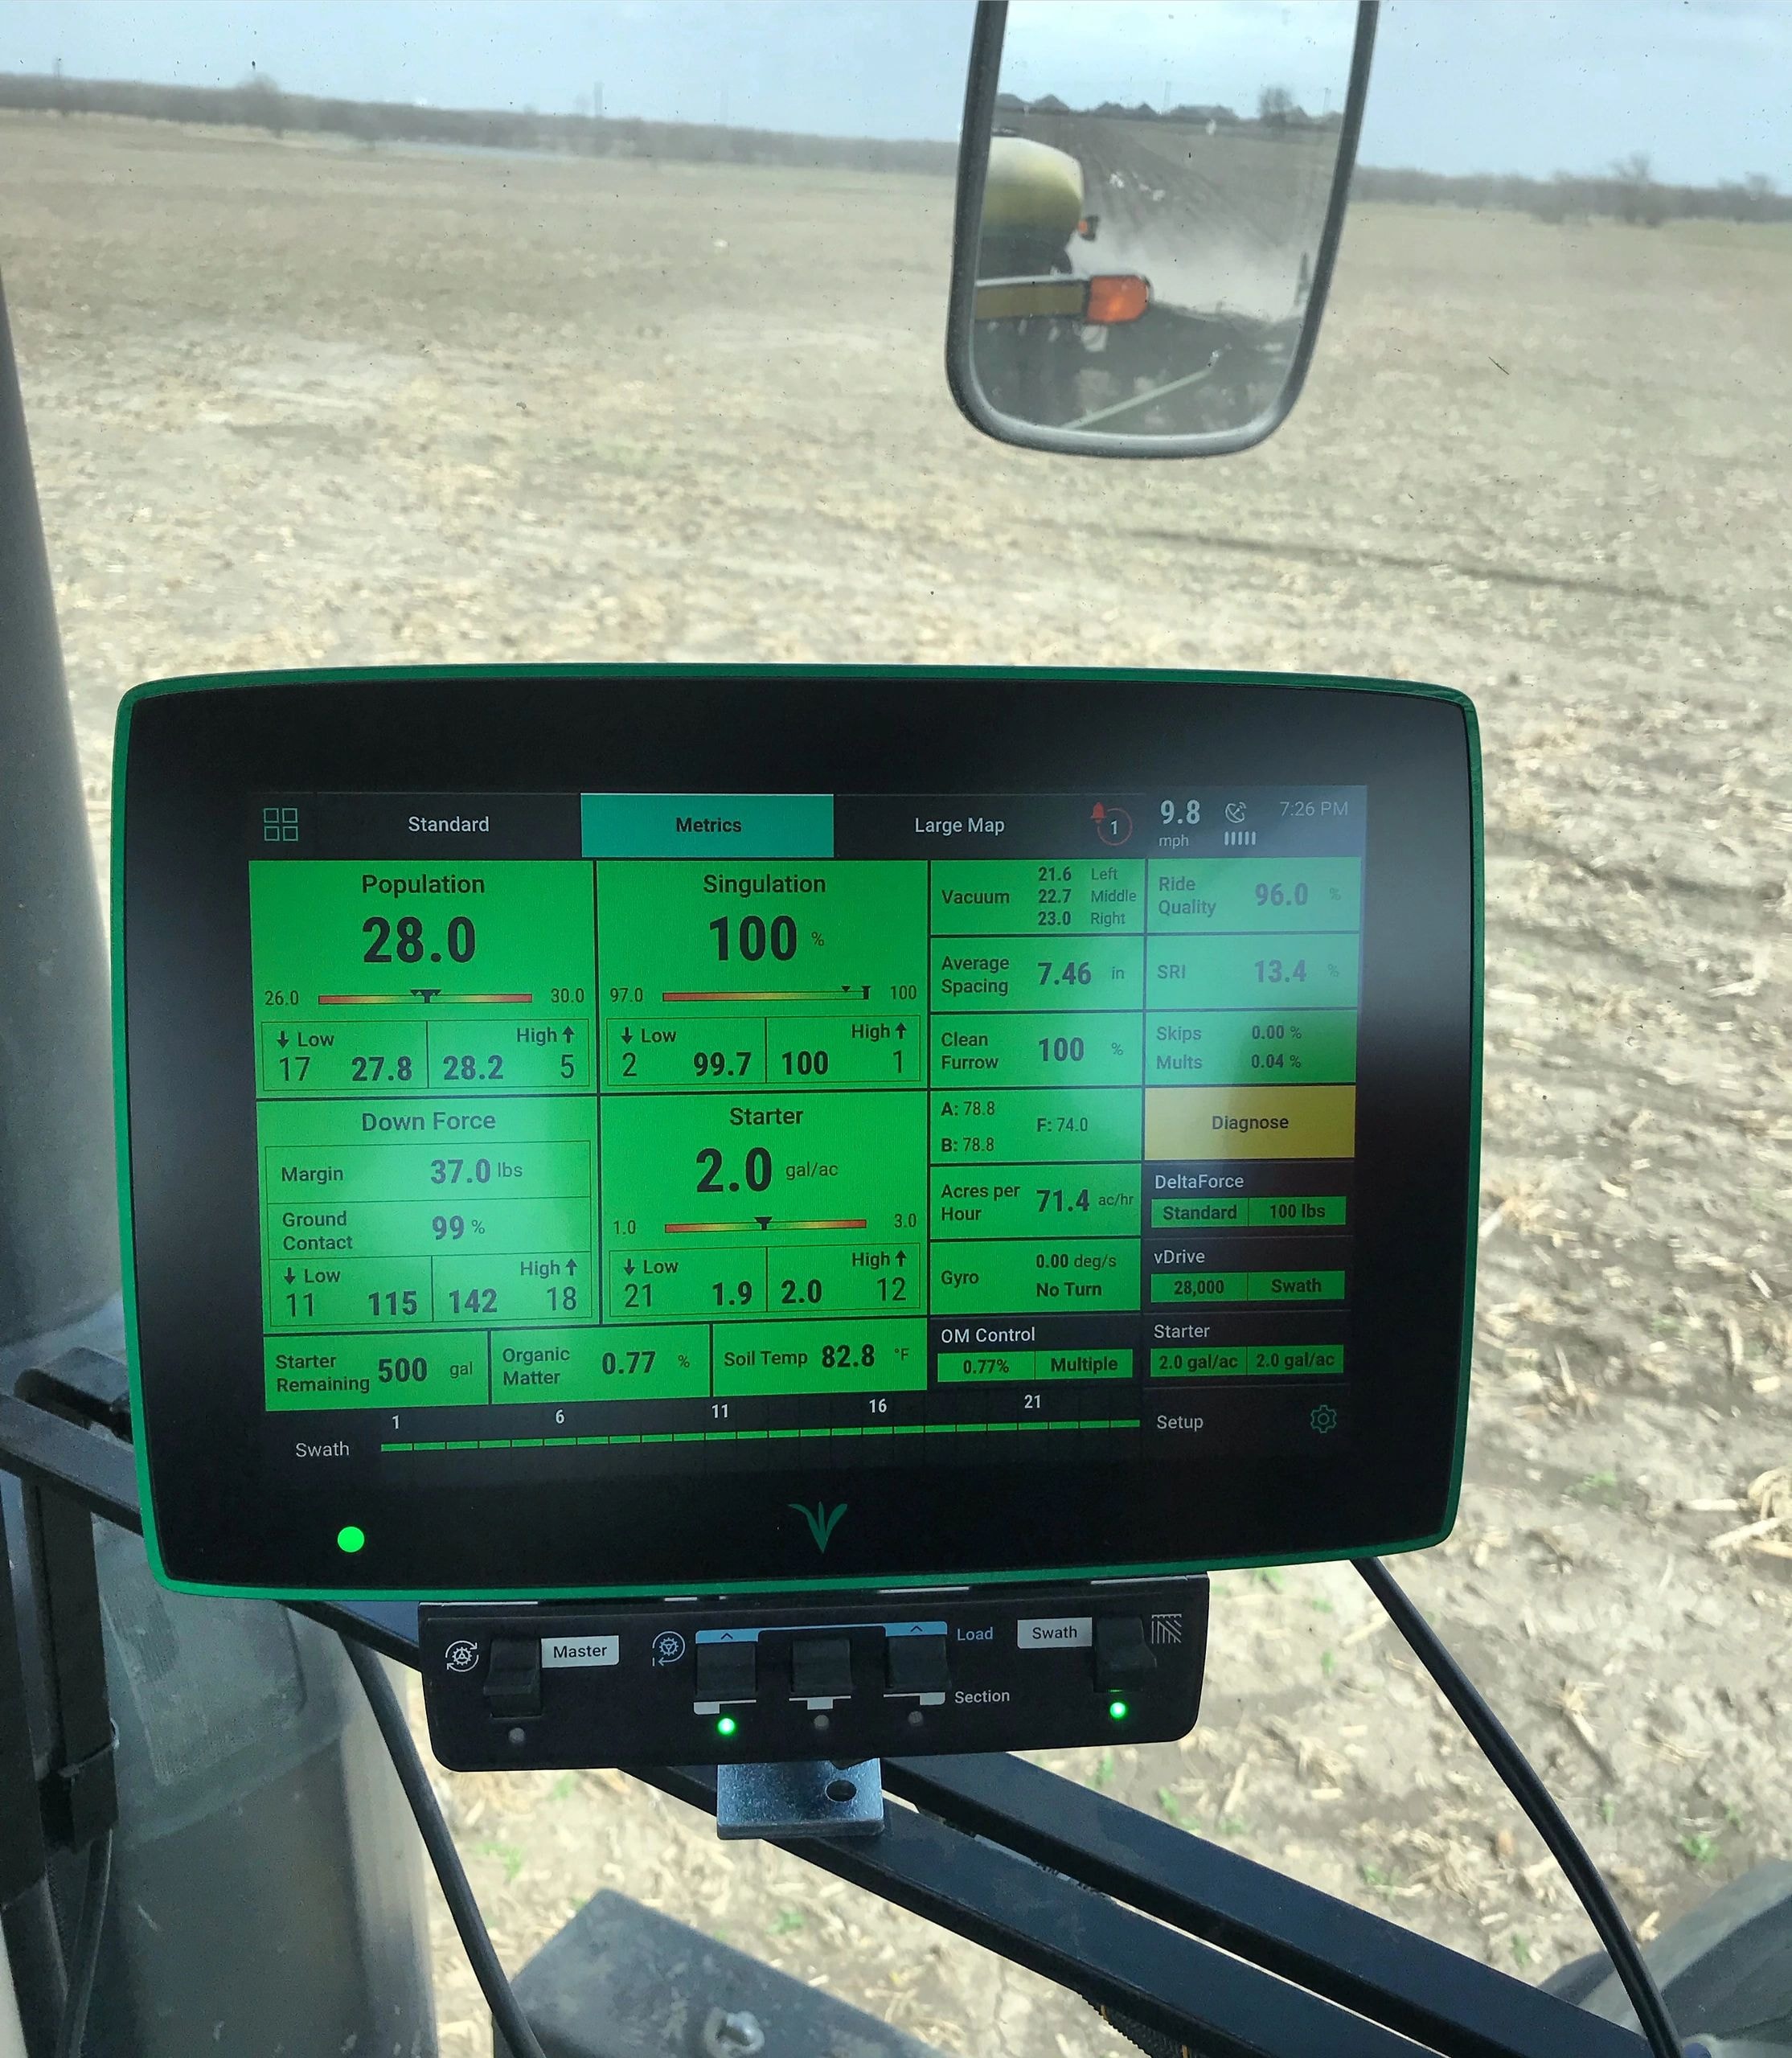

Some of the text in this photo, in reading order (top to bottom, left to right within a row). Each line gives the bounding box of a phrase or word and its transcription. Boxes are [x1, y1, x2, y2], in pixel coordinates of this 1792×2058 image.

[1161, 800, 1199, 824] 9.8
[1280, 801, 1347, 816] 7:26 PM
[409, 816, 489, 831] Standard
[677, 817, 743, 833] Metrics
[916, 818, 1004, 835] Large Map
[1111, 820, 1117, 834] 1
[1159, 834, 1188, 849] mph
[1039, 866, 1117, 882] 21.6 Left
[362, 874, 485, 898] Population
[703, 874, 825, 899] Singulation
[1159, 876, 1195, 891] Ride
[941, 890, 1011, 905] Vacuum
[1039, 888, 1137, 903] 22.7 Middle
[1256, 883, 1308, 906] 96.0
[1158, 899, 1216, 917] Quality
[1038, 910, 1126, 927] 23.0 Right
[363, 915, 476, 964] 28.0
[709, 914, 798, 961] 100
[941, 956, 1010, 974] Average
[1038, 961, 1124, 985] 7.46 in
[1158, 965, 1185, 978] SRI
[1255, 960, 1306, 982] 13.4
[552, 987, 585, 1003] 30.0
[609, 986, 643, 1003] 97.0
[891, 985, 917, 1000] 100
[941, 978, 1010, 997] Spacing
[265, 990, 299, 1006] 26.0
[298, 1032, 334, 1047] Low
[517, 1027, 557, 1046] High
[641, 1029, 677, 1043] Low
[851, 1023, 891, 1042] High
[941, 1031, 989, 1047] Clean
[1157, 1026, 1201, 1043] Skips
[1252, 1025, 1285, 1040] 0.00
[1039, 1036, 1085, 1061] 100
[280, 1057, 310, 1081] 17
[352, 1056, 412, 1081] 27.8
[444, 1055, 503, 1080] 28.2
[561, 1053, 575, 1079] 5
[622, 1052, 637, 1077] 2
[693, 1051, 751, 1076] 99.7
[782, 1050, 829, 1076] 100
[893, 1050, 902, 1073] 1
[941, 1054, 999, 1070] Furrow
[1157, 1055, 1202, 1069] Mults
[1249, 1053, 1283, 1068] 0.04
[730, 1106, 803, 1125] Starter
[941, 1100, 995, 1117] A: 78.8
[363, 1111, 495, 1131] Down Force
[1037, 1117, 1089, 1132] F: 74.0
[1212, 1114, 1289, 1133] Diagnose
[941, 1136, 995, 1152] B: 78.8
[282, 1166, 343, 1184] Margin
[431, 1158, 522, 1184] 37.0 lbs
[695, 1146, 838, 1193] 2.0 gal/ac
[1156, 1175, 1244, 1189] DeltaForce
[941, 1184, 1020, 1201] Acres per
[1037, 1188, 1134, 1213] 71.4 ac/hr
[941, 1207, 982, 1221] Hour
[1163, 1204, 1236, 1220] Standard
[1270, 1203, 1325, 1218] 100 lbs
[283, 1211, 347, 1228] Ground
[433, 1215, 464, 1240] 99
[614, 1220, 636, 1235] 1.0
[894, 1213, 917, 1228] 3.0
[283, 1235, 352, 1250] Contact
[852, 1252, 891, 1269] High
[1036, 1253, 1116, 1270] 0.00 deg/s
[1154, 1249, 1204, 1263] vDrive
[521, 1260, 560, 1279] High
[643, 1260, 679, 1273] Low
[304, 1269, 340, 1283] Low
[941, 1269, 979, 1288] Gyro
[713, 1280, 752, 1306] 1.9
[781, 1279, 822, 1304] 2.0
[877, 1277, 907, 1301] 12
[1036, 1281, 1103, 1297] No Turn
[1175, 1279, 1225, 1297] 28,000
[1270, 1277, 1322, 1293] Swath
[369, 1289, 418, 1315] 115
[449, 1289, 497, 1314] 142
[547, 1286, 576, 1310] 18
[625, 1283, 652, 1308] 21
[287, 1292, 314, 1317] 11
[942, 1326, 1035, 1343] OM Control
[1154, 1325, 1210, 1338] Starter
[276, 1355, 336, 1370] Starter
[502, 1347, 570, 1366] Organic
[602, 1351, 656, 1375] 0.77
[724, 1350, 807, 1367] Soil Temp
[822, 1344, 875, 1367] 82.8
[1159, 1354, 1237, 1372] 2.0 gal/ac
[1257, 1352, 1335, 1370] 2.0 gal/ac
[379, 1356, 472, 1383] 500 gal
[964, 1359, 1010, 1374] 0.77%
[1052, 1356, 1117, 1374] Multiple
[277, 1376, 371, 1393] Remaining
[503, 1371, 560, 1385] Matter
[870, 1399, 887, 1412] 16
[1025, 1395, 1040, 1408] 21
[556, 1410, 564, 1423] 6
[712, 1404, 728, 1418] 11
[392, 1416, 398, 1429] 1
[1157, 1415, 1203, 1432] Setup
[296, 1441, 349, 1457] Swath
[957, 1626, 994, 1642] Load
[1032, 1625, 1077, 1640] Swath
[553, 1645, 608, 1658] Master
[954, 1689, 1010, 1704] Section
